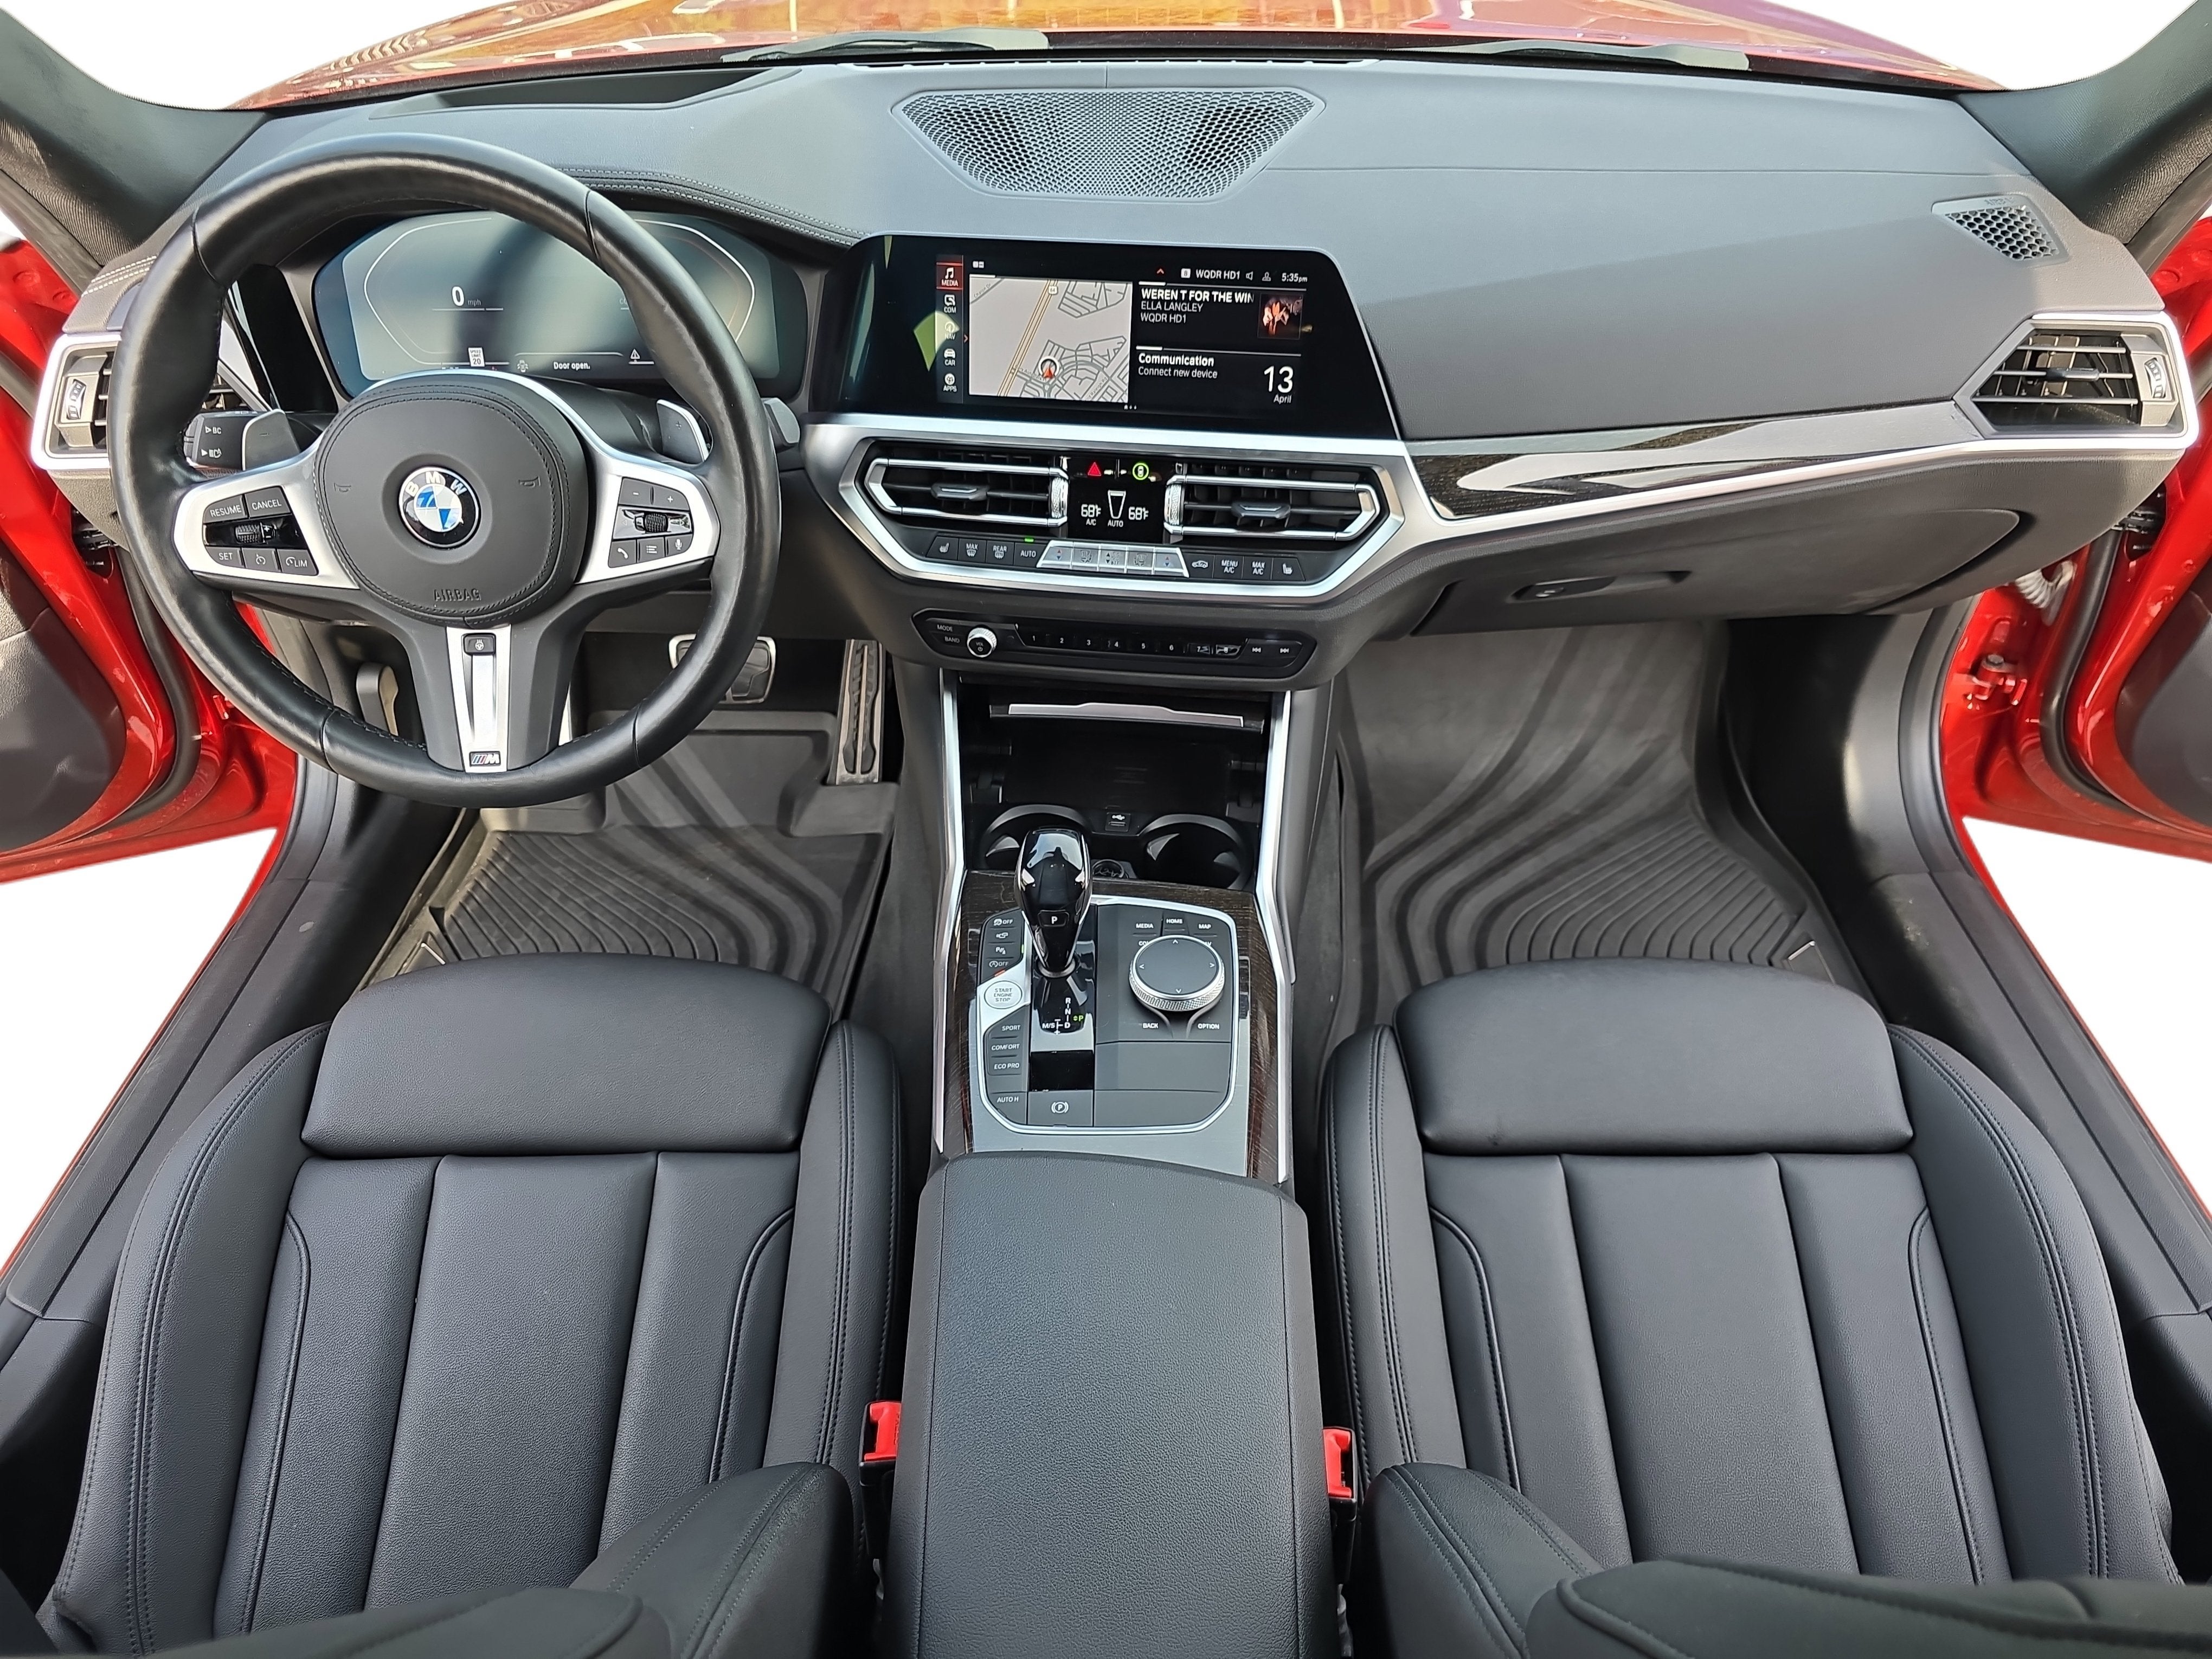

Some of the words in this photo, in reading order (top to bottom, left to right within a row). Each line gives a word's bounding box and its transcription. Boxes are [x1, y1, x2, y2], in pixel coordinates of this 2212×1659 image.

[1196, 269, 1221, 279] WQDR
[1223, 270, 1240, 280] HD1
[1282, 273, 1308, 283] 5:35pm
[452, 286, 465, 306] 0
[1141, 288, 1178, 300] WEREN
[1180, 290, 1187, 299] T
[1189, 291, 1210, 301] FOR
[1212, 291, 1233, 303] THE
[1141, 301, 1162, 311] ELLA
[1164, 302, 1204, 312] LANGLEY
[1140, 312, 1167, 323] WQDR
[1169, 314, 1186, 323] HD1
[1139, 353, 1214, 367] Communication
[554, 362, 570, 370] Door
[571, 362, 590, 371] open.
[1139, 366, 1172, 377] Connect
[1173, 369, 1189, 377] new
[1192, 368, 1218, 379] device
[1264, 365, 1294, 394] 13
[1274, 394, 1292, 404] April
[405, 471, 467, 497] BMW
[252, 499, 282, 511] CANCEL
[210, 505, 242, 517] RESUME
[218, 552, 233, 561] SET
[294, 558, 307, 568] LIM
[1221, 560, 1238, 568] MENU
[434, 588, 481, 602] AIRBAG
[937, 624, 953, 632] MODE
[1051, 916, 1057, 924] P
